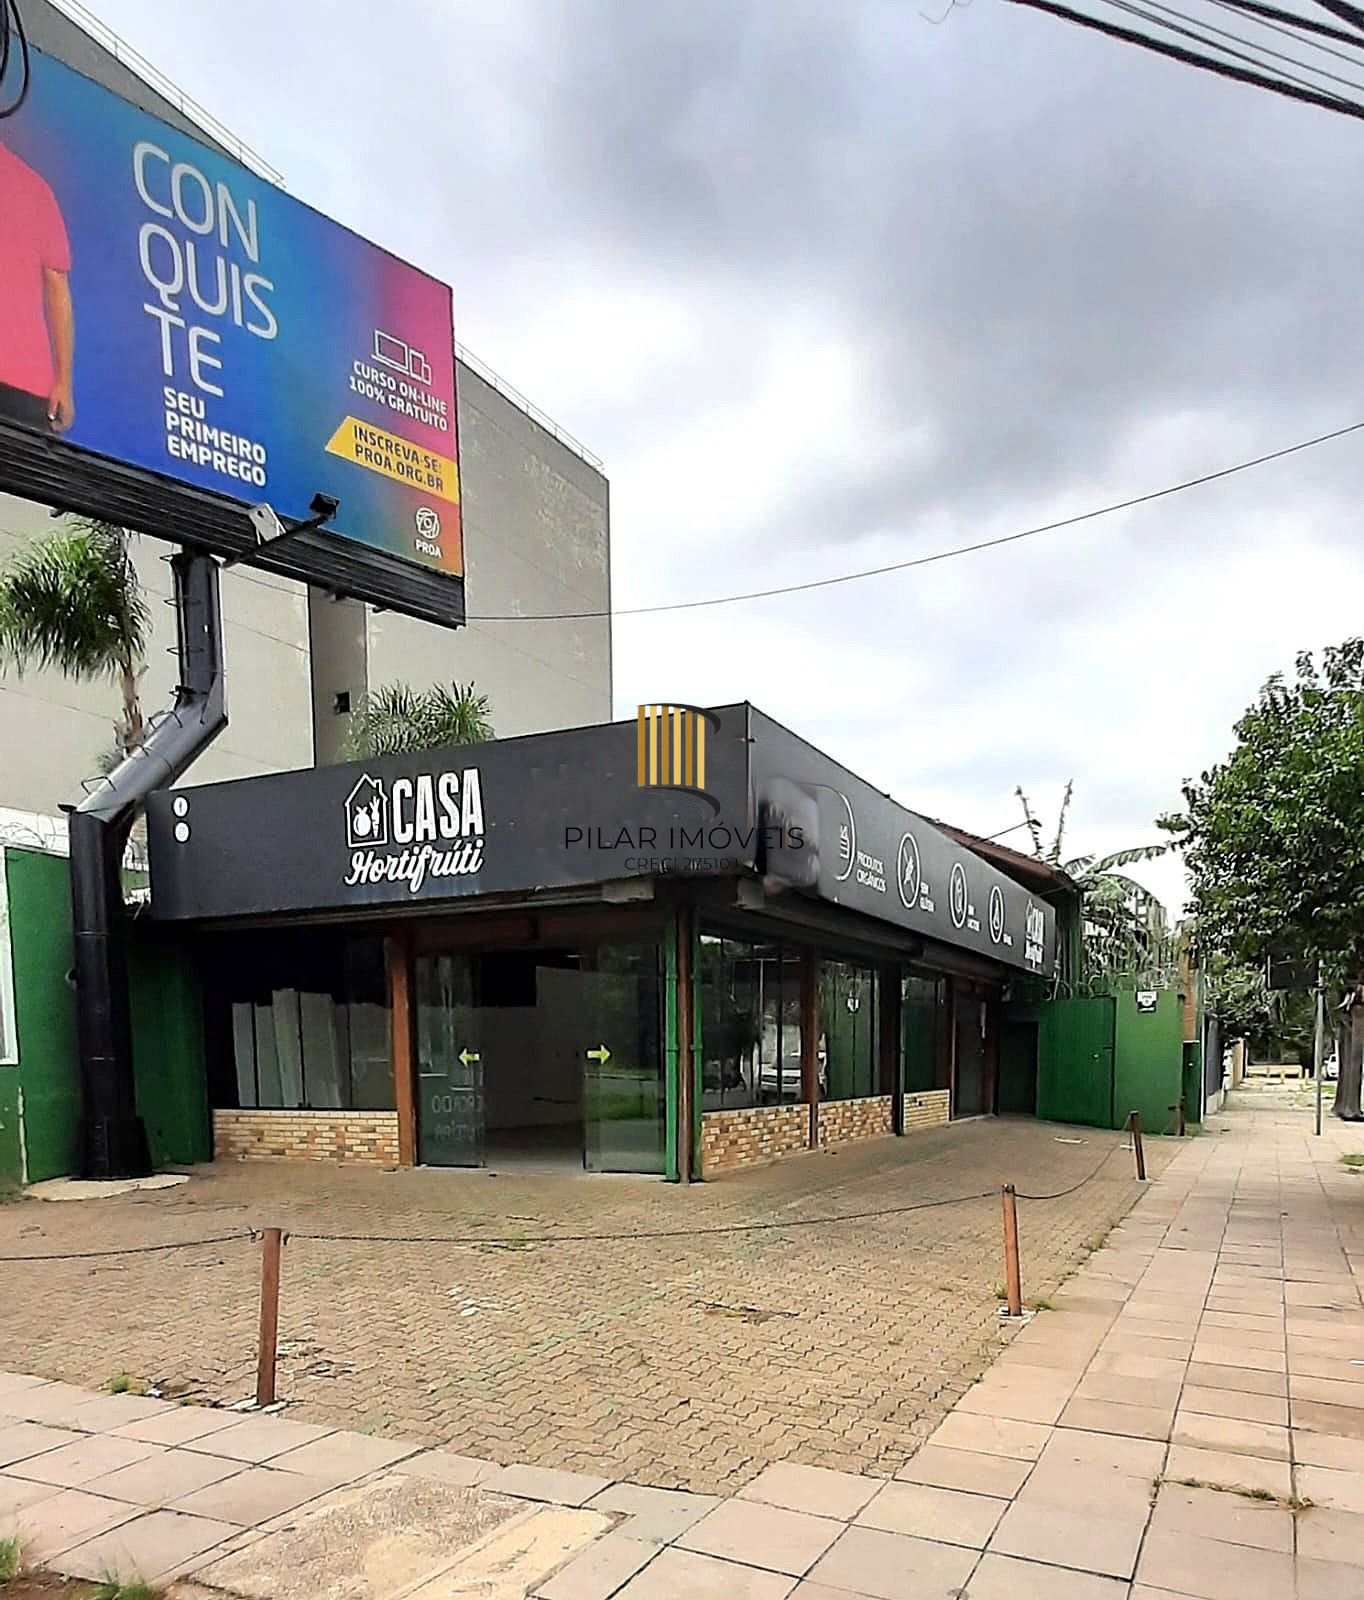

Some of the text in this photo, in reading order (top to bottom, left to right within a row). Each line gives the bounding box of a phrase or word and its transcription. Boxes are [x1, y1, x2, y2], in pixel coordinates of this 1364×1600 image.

[133, 141, 259, 263] CON
[139, 223, 278, 340] QUIS
[143, 302, 224, 398] TE
[164, 386, 205, 420] SEU
[349, 375, 448, 432] 100% GRATUITO
[353, 360, 448, 415] CURSO ON-LINE
[165, 410, 266, 465] PRIMEIRO
[167, 434, 266, 487] EMPREGO
[354, 443, 444, 492] PROA.ORG.BR
[415, 538, 442, 559] PROA
[392, 768, 484, 843] CASA
[344, 839, 484, 893] Hortifrúti
